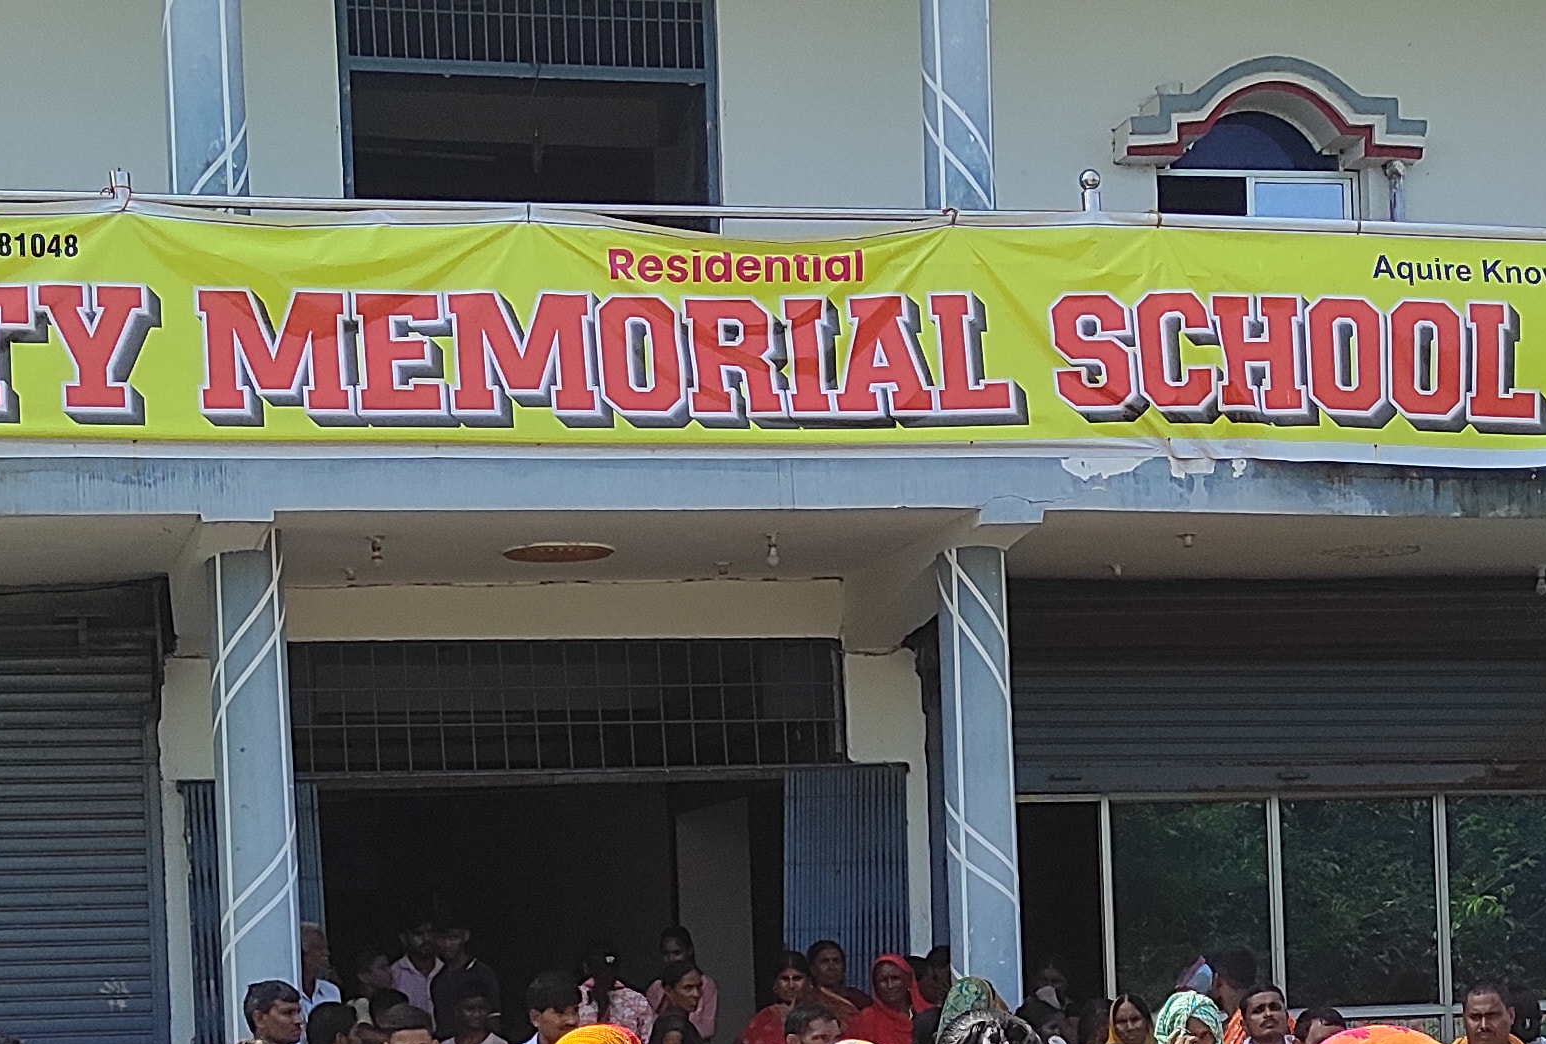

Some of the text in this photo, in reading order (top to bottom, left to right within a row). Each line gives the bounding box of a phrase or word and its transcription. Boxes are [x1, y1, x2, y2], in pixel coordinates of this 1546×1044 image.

[607, 247, 866, 284] Residential
[1373, 254, 1472, 287] Aquire
[195, 287, 1029, 430] MEMORIAL
